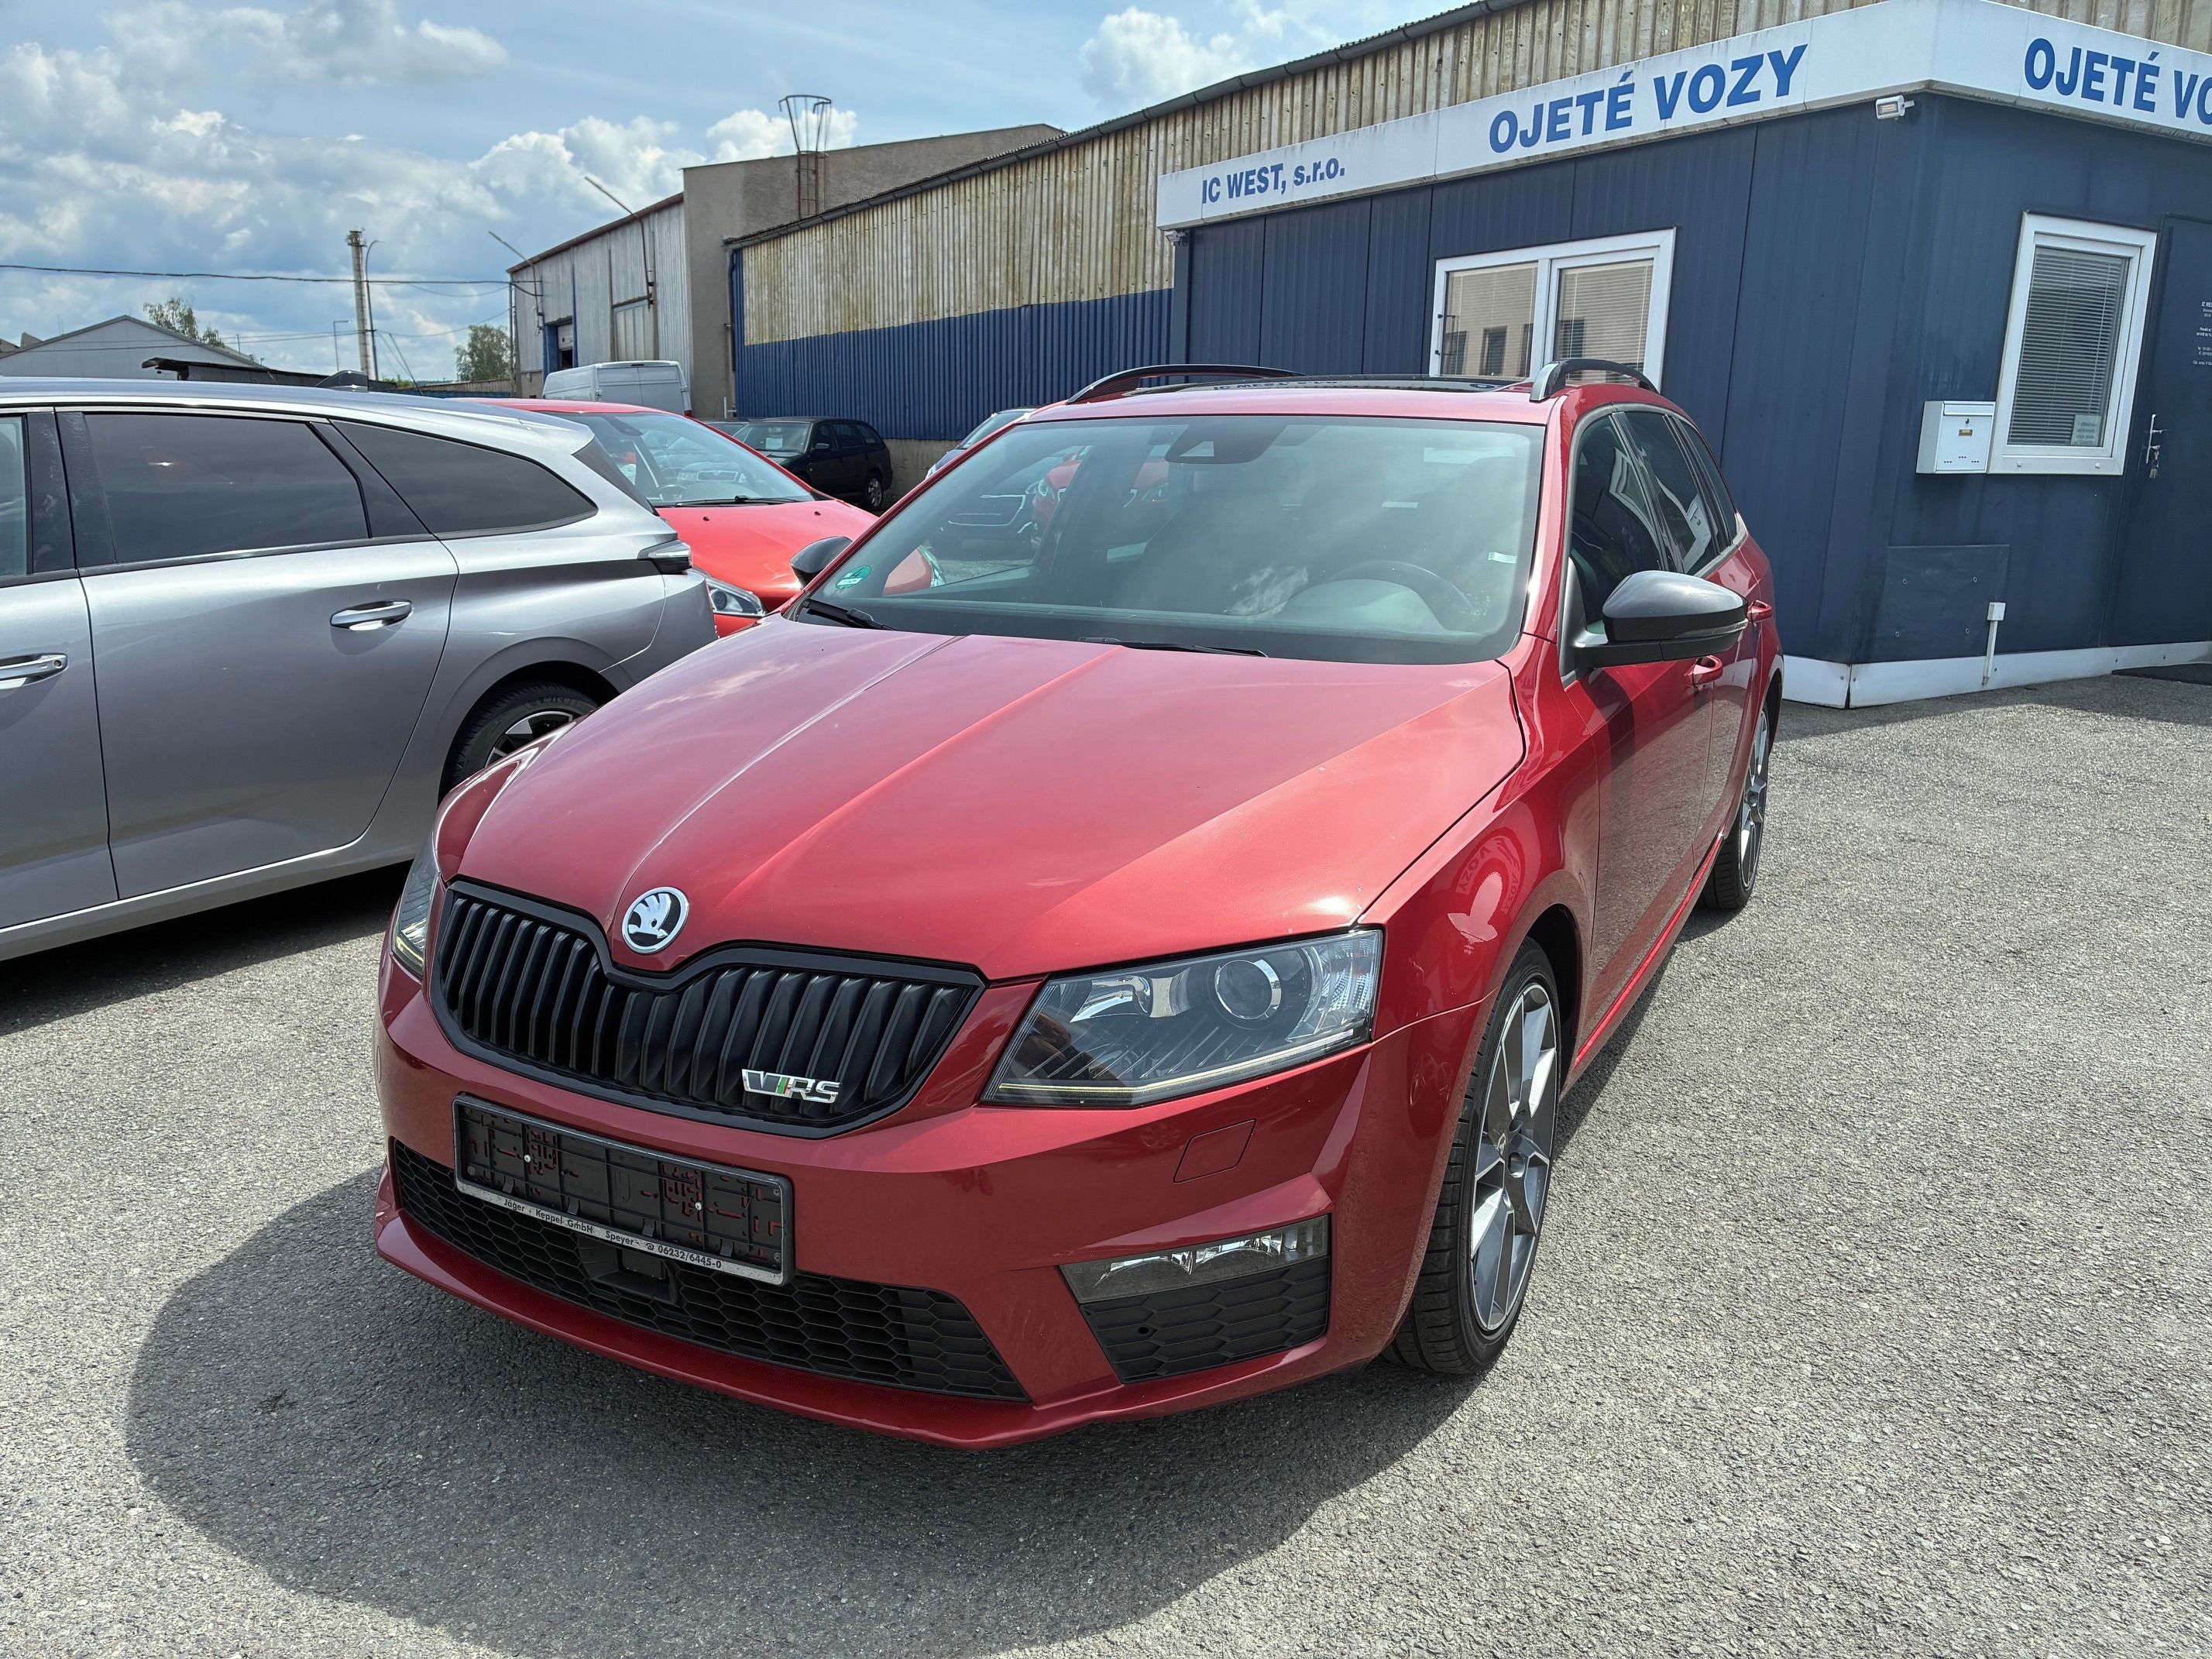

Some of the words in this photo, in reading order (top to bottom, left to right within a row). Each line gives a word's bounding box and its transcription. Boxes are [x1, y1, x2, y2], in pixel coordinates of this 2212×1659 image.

[1489, 71, 1635, 153] OJETÉ
[1654, 43, 1808, 121] VOZY
[2024, 37, 2160, 113] OJETÉ
[1202, 177, 1221, 204] IC
[1227, 163, 1286, 199] WEST,
[1293, 157, 1345, 187] s.r.o.
[503, 1198, 525, 1212] Jäger
[535, 1208, 563, 1225] Keppel
[567, 1219, 594, 1234] GmbH
[605, 1230, 634, 1246] Speyer
[658, 1244, 722, 1269] 06232/6445-0
